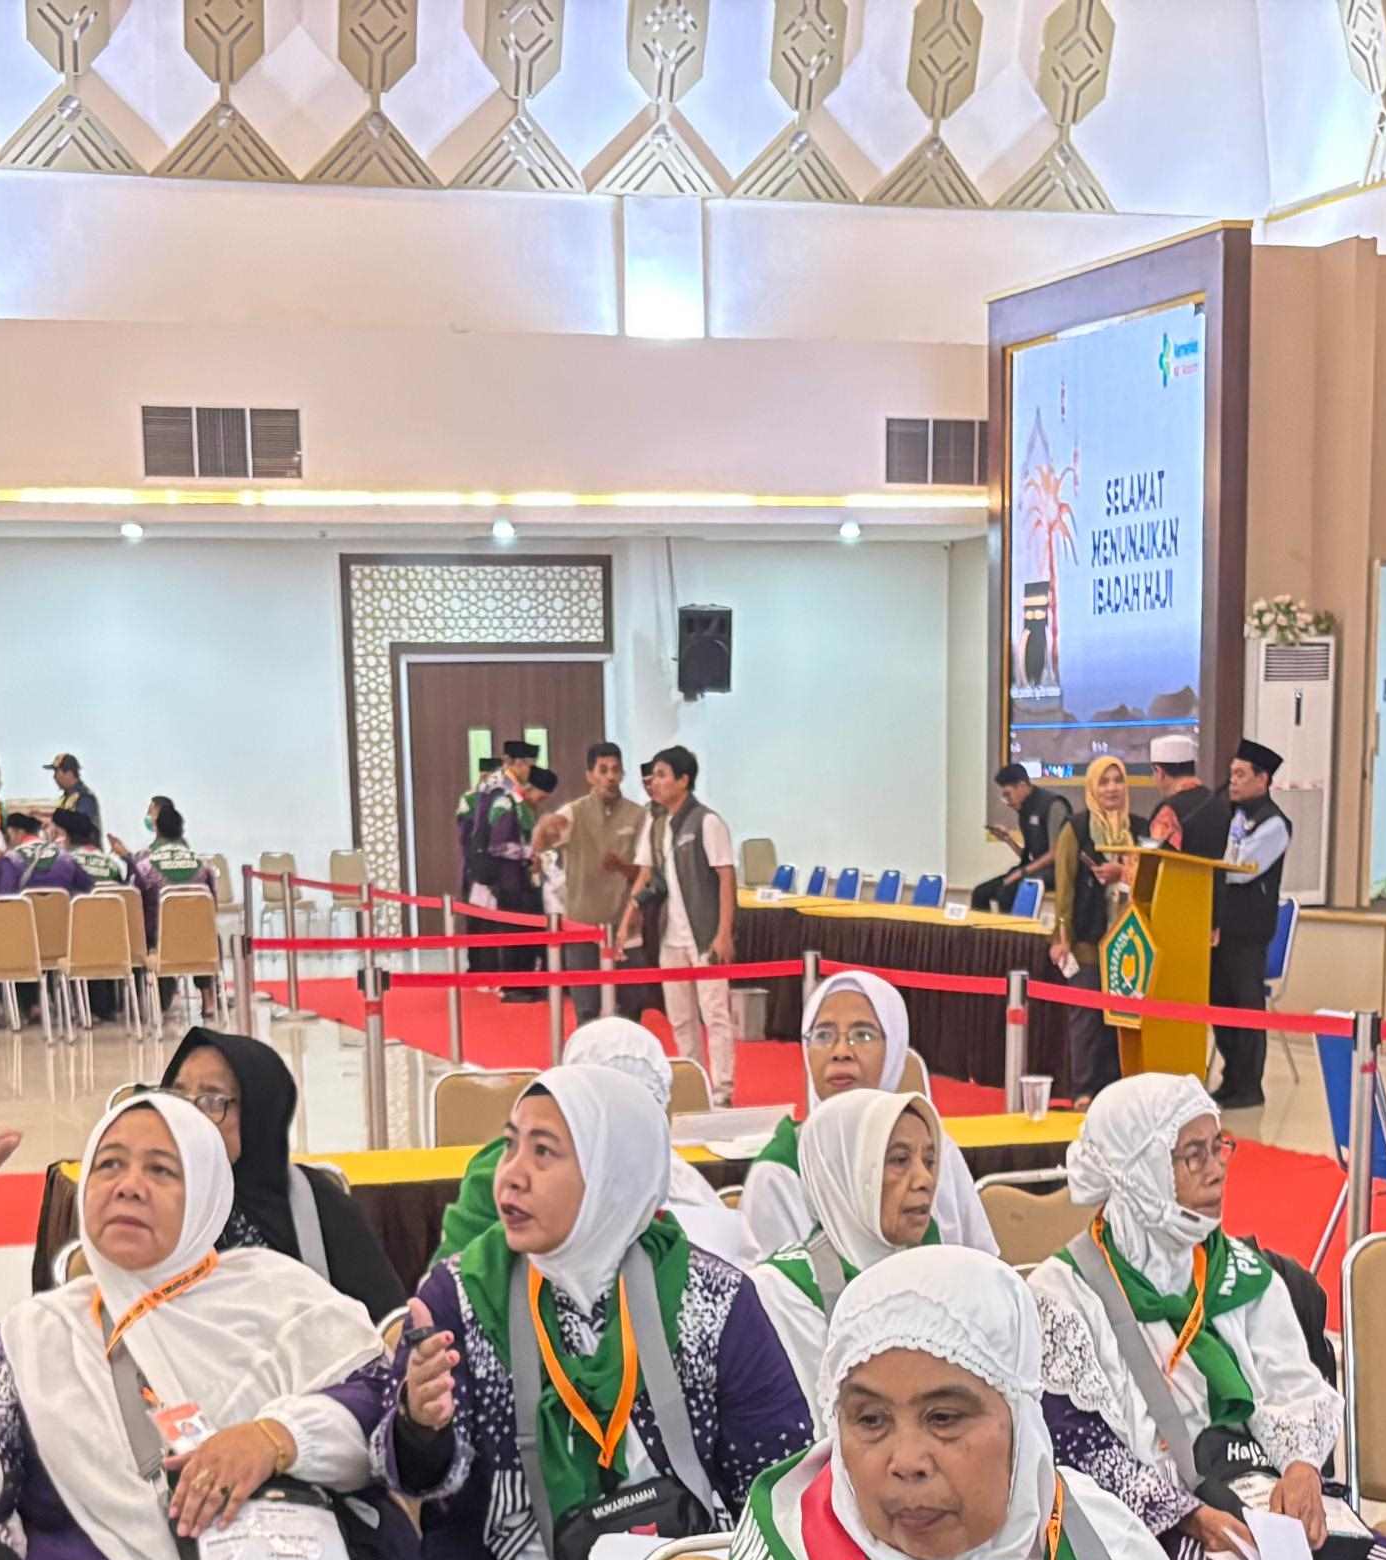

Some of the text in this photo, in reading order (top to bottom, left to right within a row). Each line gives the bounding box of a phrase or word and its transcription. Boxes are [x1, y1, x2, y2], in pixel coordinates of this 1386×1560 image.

[1106, 470, 1165, 517] SELAMAT
[1091, 516, 1179, 568] MENUNAIKAN
[1092, 568, 1173, 615] IBADAH HAJI
